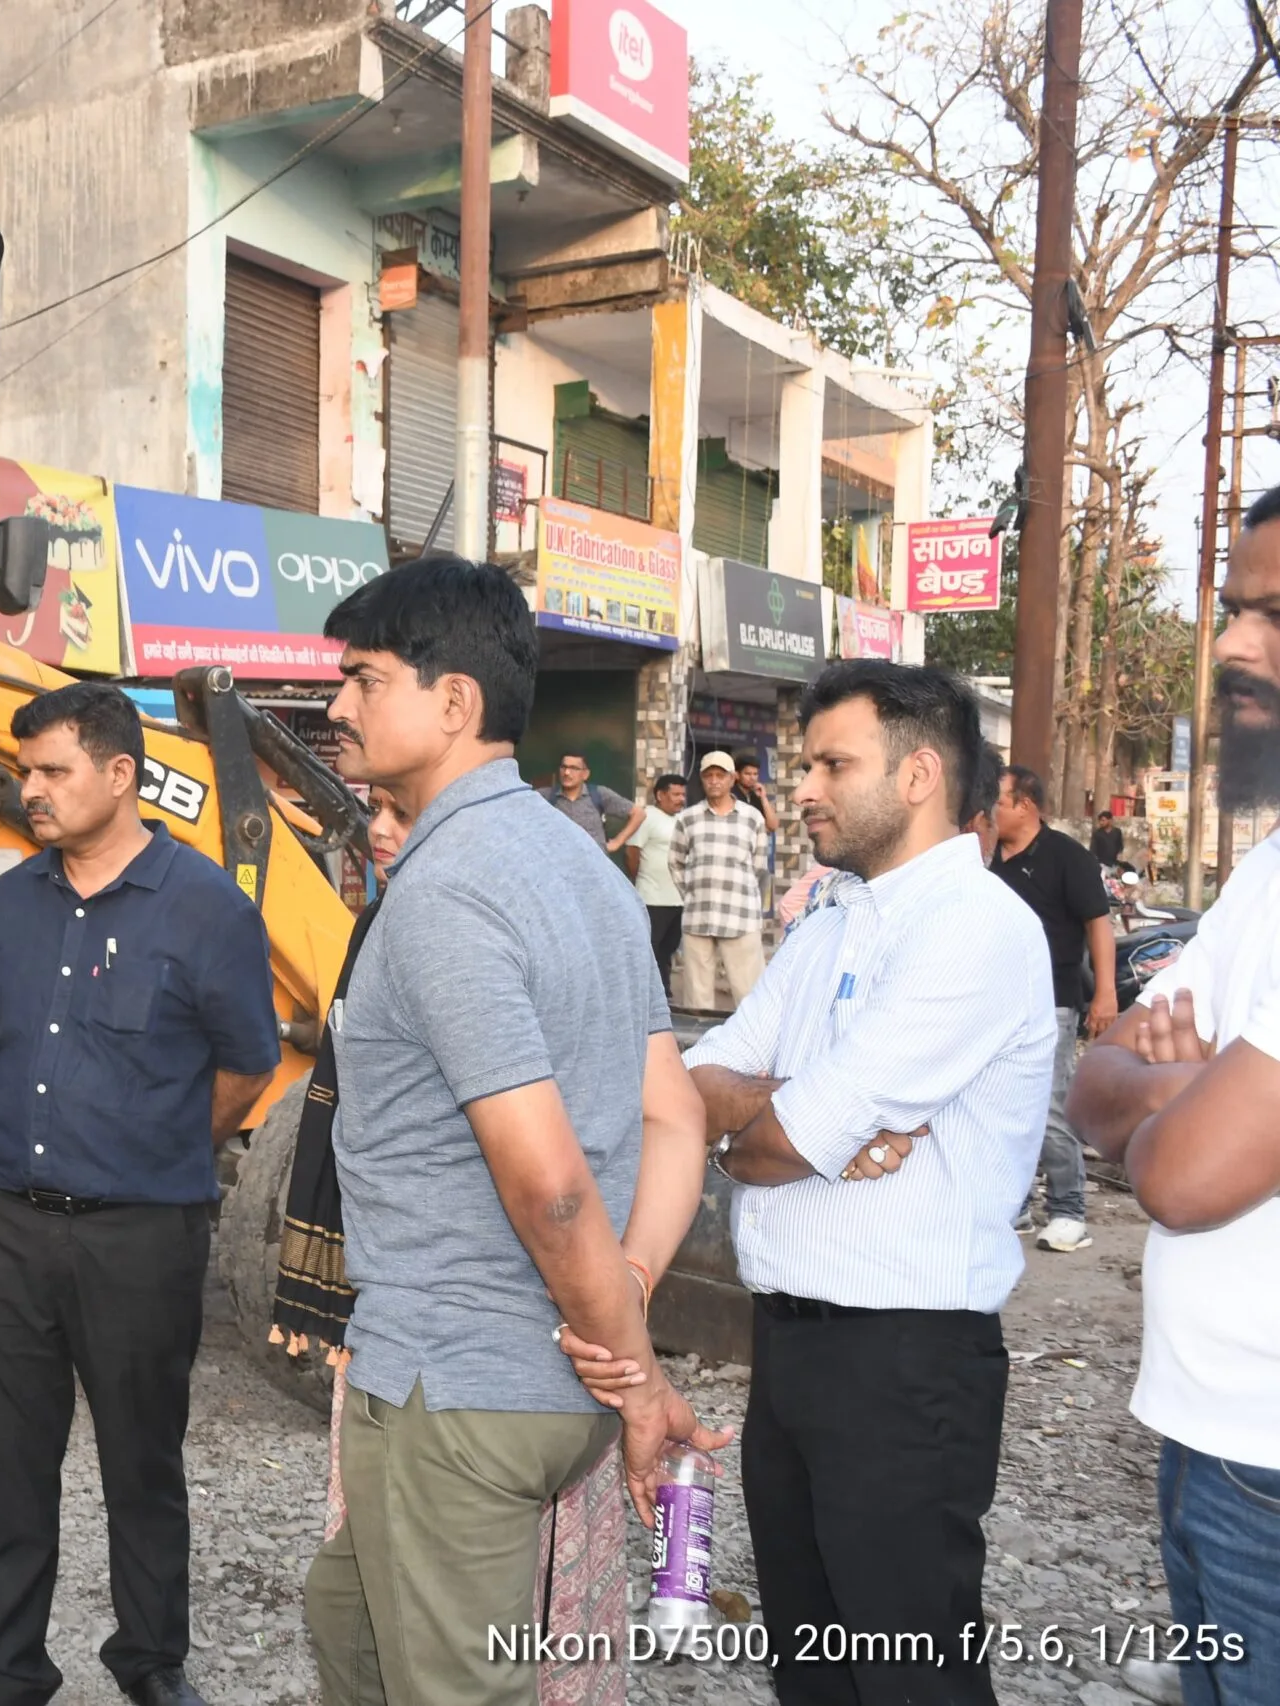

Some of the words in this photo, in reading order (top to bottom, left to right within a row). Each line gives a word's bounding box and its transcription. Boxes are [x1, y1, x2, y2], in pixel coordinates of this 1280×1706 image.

[618, 20, 645, 68] itel
[134, 528, 261, 599] vivo
[276, 551, 385, 596] oppo
[545, 521, 568, 555] U.K.
[569, 529, 636, 573] Fabrication
[637, 550, 646, 573] &
[647, 549, 677, 581] Glass
[911, 532, 993, 563] साजन
[758, 626, 785, 652] DRUG
[784, 631, 816, 658] HOUSE
[138, 756, 205, 820] CB
